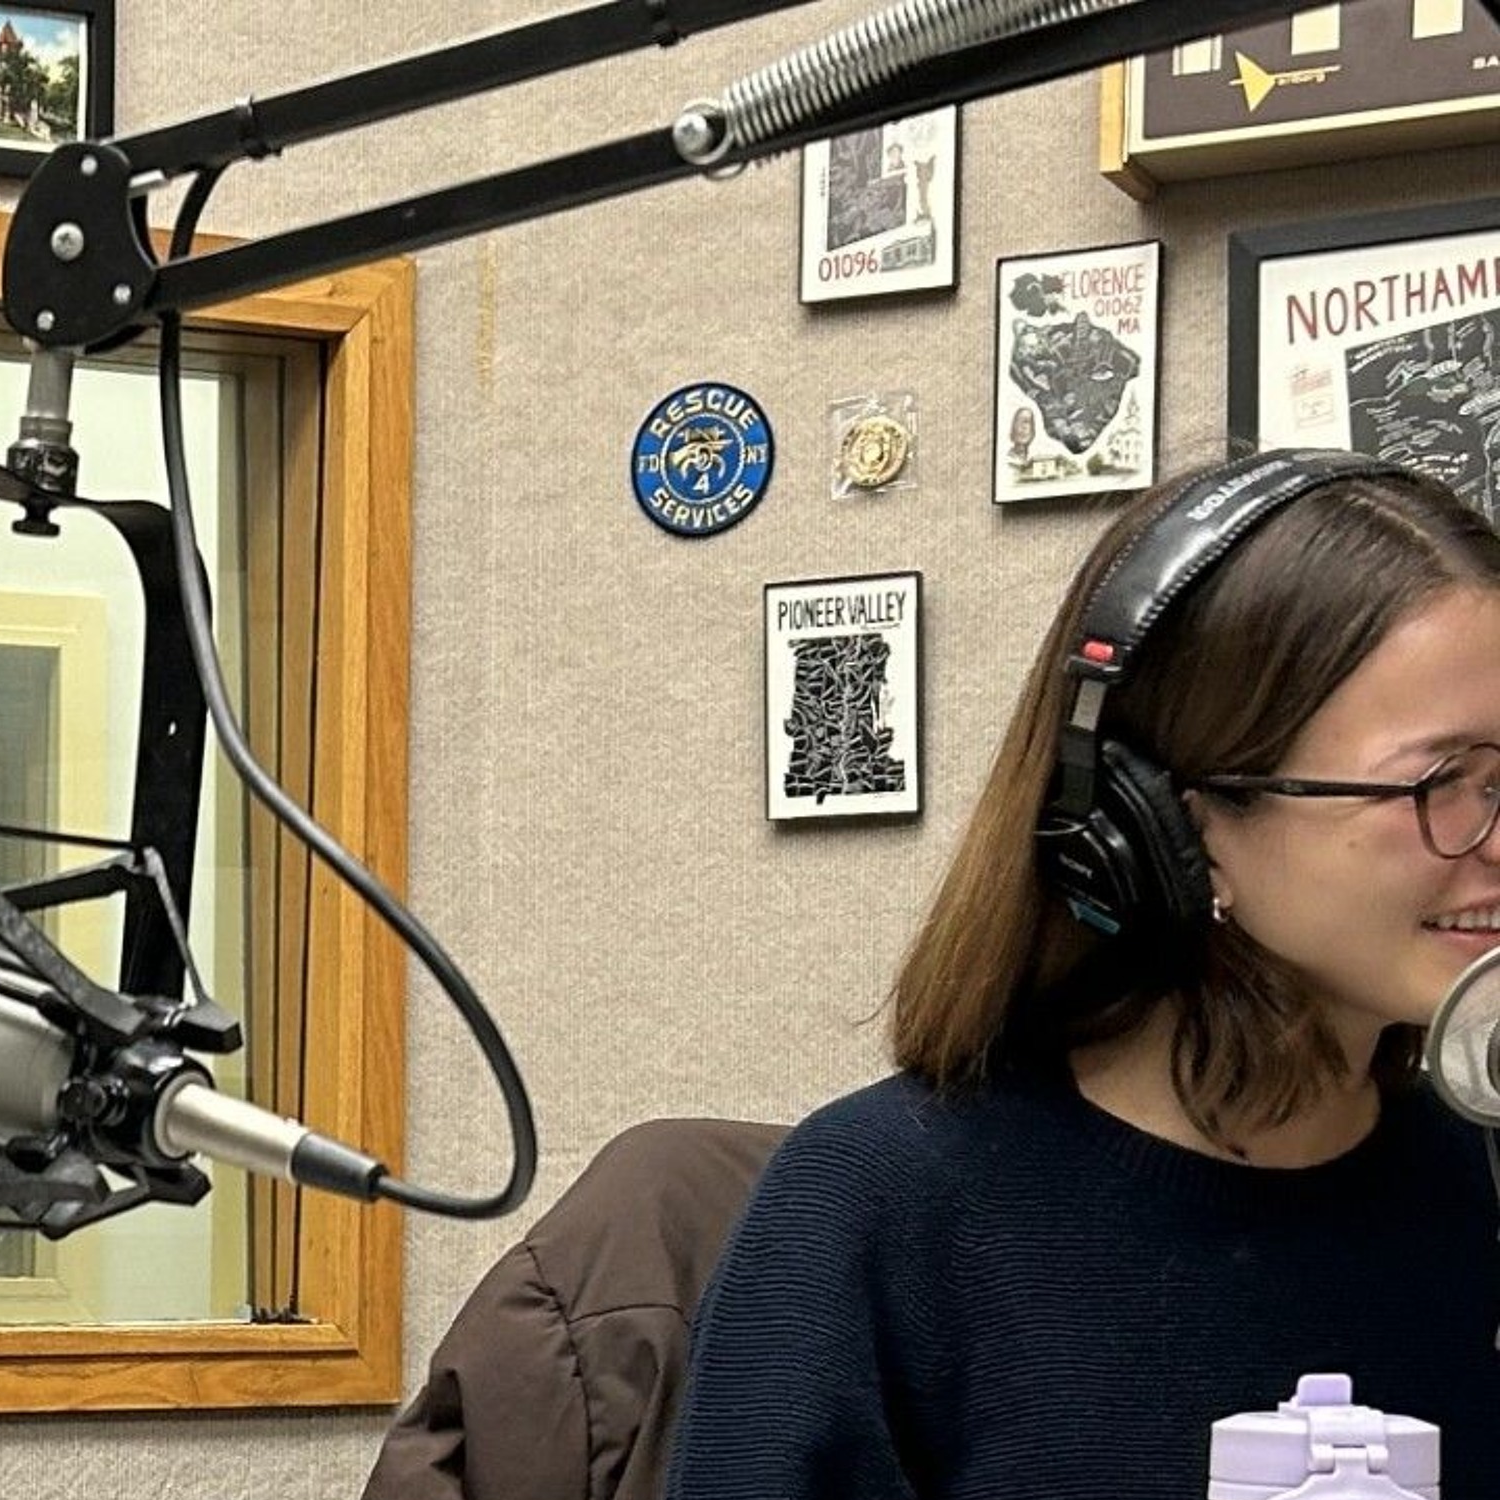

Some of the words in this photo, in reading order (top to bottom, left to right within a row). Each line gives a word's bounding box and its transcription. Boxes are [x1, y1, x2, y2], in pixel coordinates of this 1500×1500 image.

[818, 250, 878, 282] 01096
[1061, 263, 1146, 300] FLORENCE
[1094, 295, 1142, 317] 01062
[1118, 317, 1141, 335] MA
[650, 388, 758, 438] RESCUE
[650, 484, 753, 528] SERVICES
[778, 596, 845, 631] PIONEER
[846, 591, 906, 626] VALLEY
